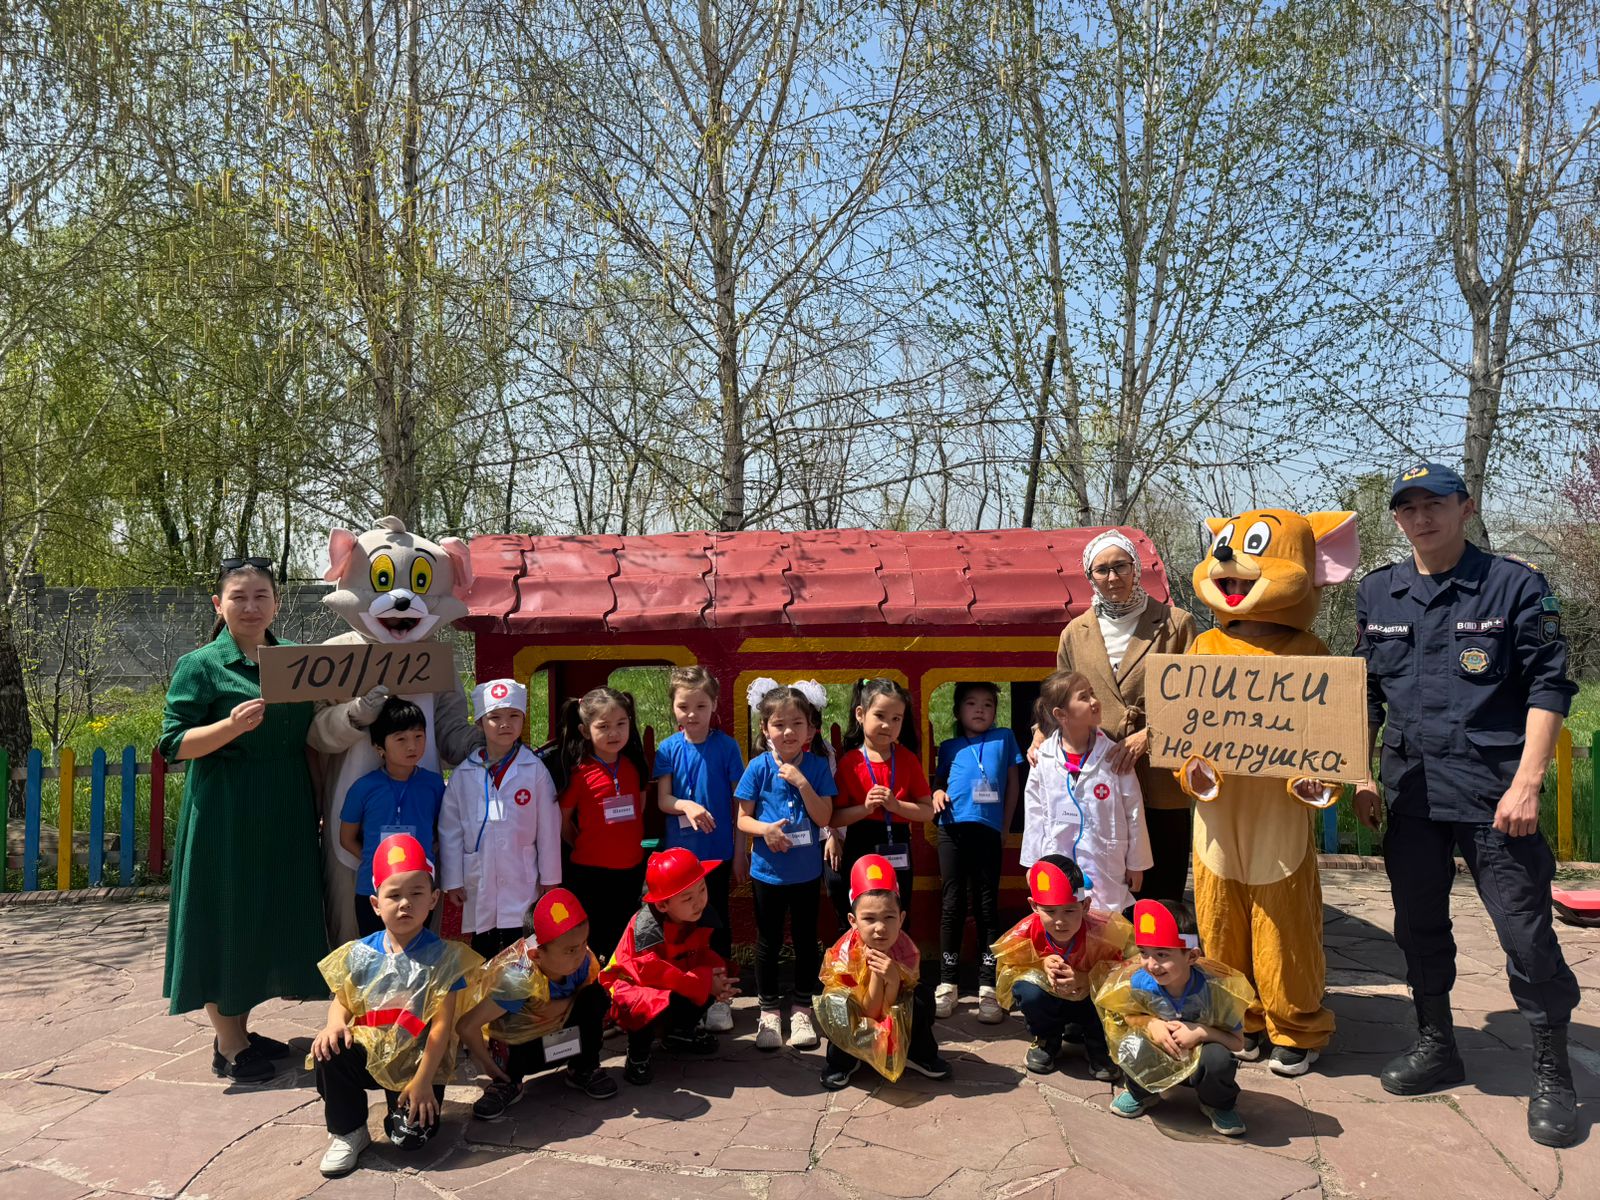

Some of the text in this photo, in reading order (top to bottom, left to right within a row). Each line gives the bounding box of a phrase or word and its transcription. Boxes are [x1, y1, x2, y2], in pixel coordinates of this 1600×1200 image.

[287, 643, 431, 698] 101/112
[1160, 663, 1329, 705] СПИЧКИ
[1182, 707, 1294, 734] детям
